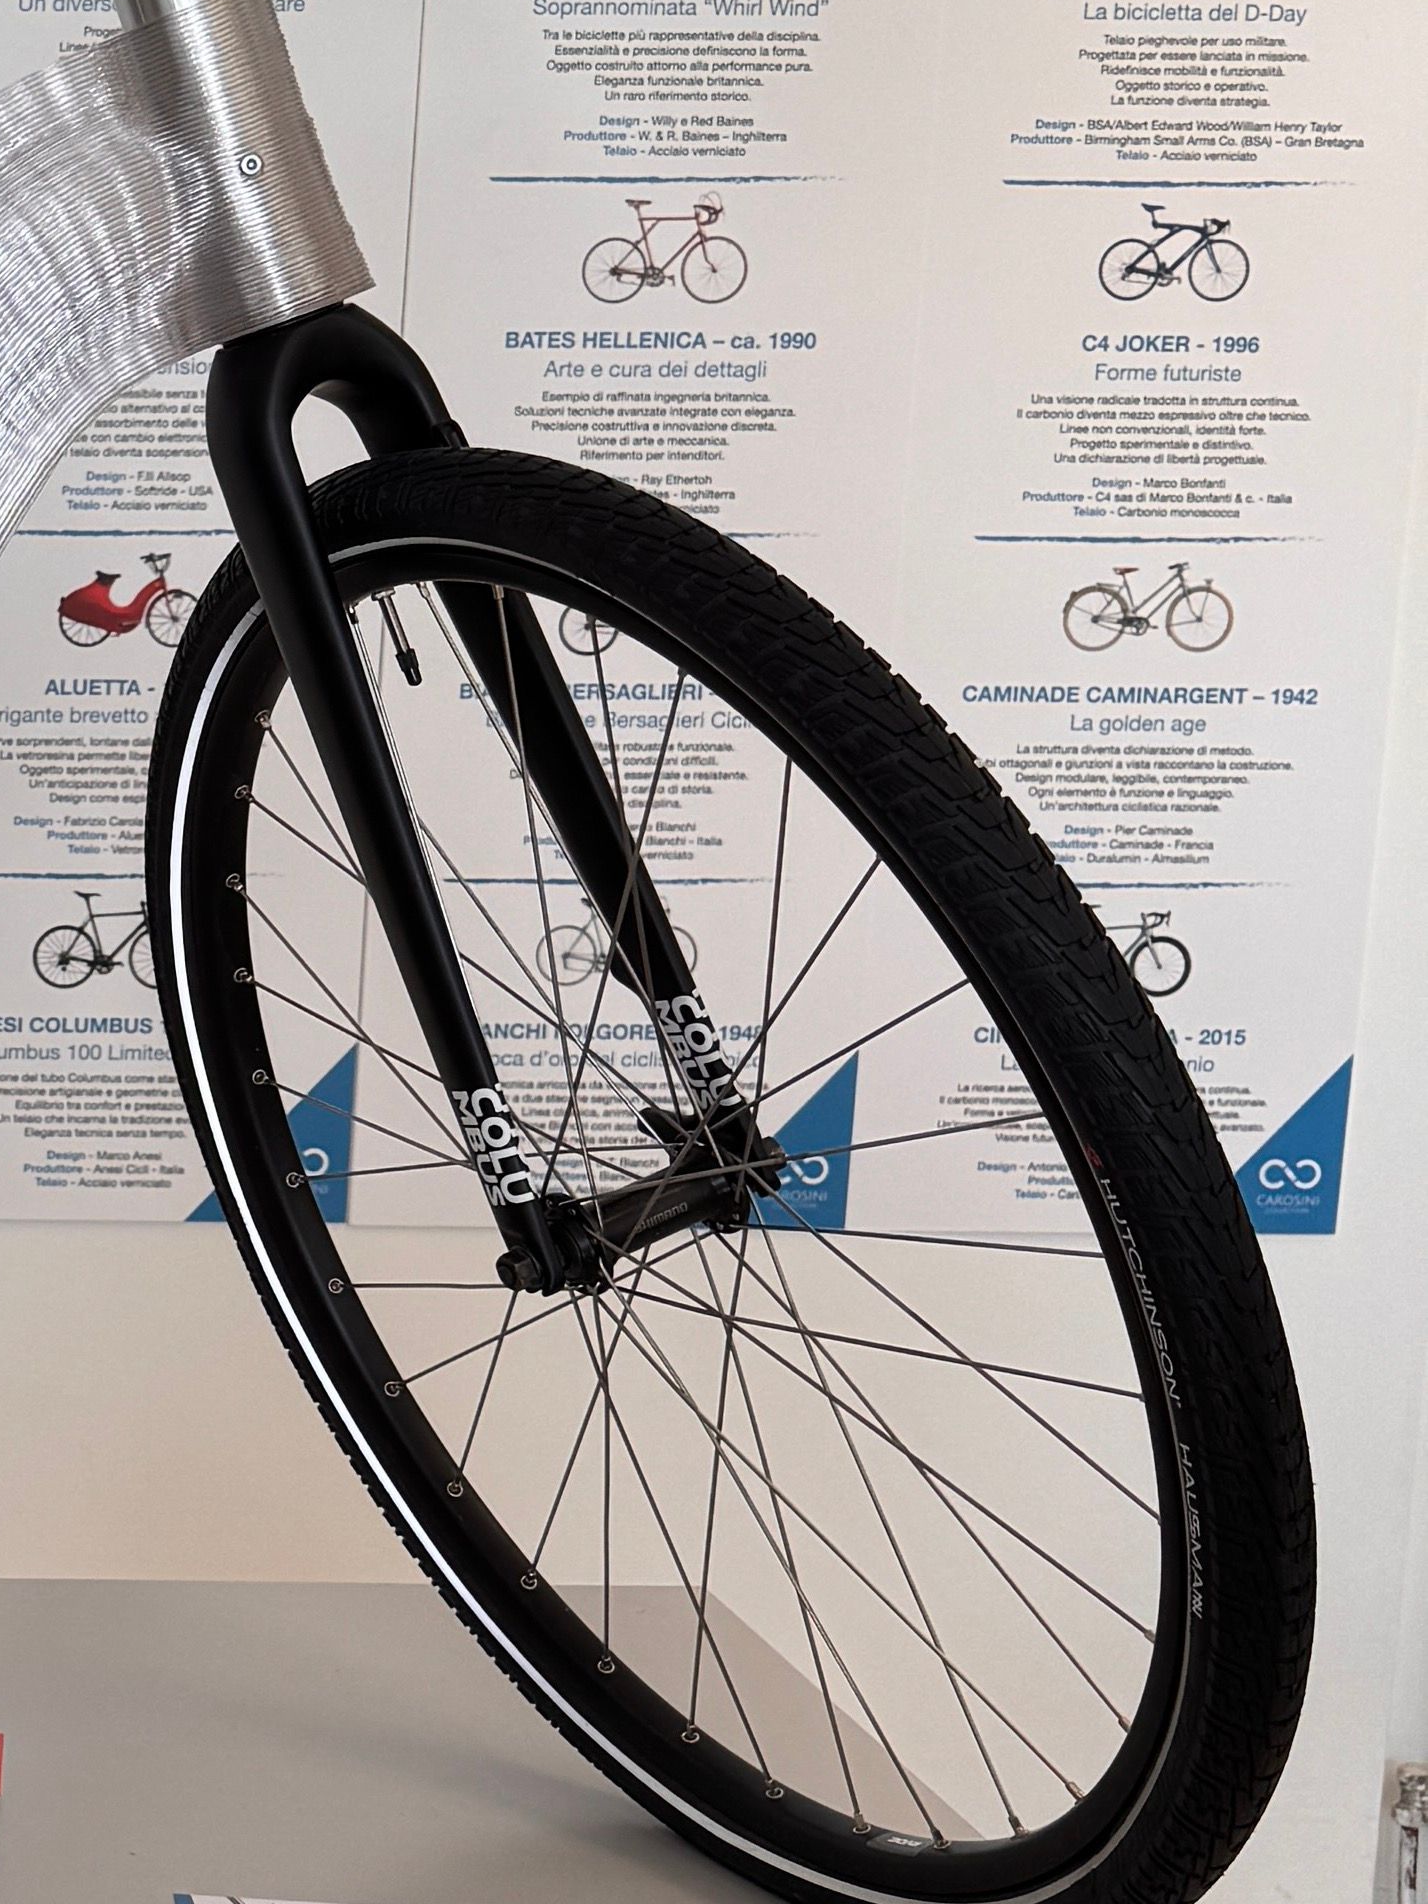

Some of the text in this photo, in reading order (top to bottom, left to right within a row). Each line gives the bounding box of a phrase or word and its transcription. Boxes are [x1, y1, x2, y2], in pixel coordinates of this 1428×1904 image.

[1083, 2, 1308, 27] La bicicletta del D-Day
[1081, 334, 1260, 354] C4 JOKER 1996
[543, 360, 767, 383] Arte e cura dei dettagli
[1094, 362, 1242, 383] Forme futuriste
[962, 685, 1318, 705] CAMINADE CAMINARGENT 1942
[1070, 713, 1207, 737] La golden age
[1198, 1028, 1246, 1046] 2015
[1101, 1178, 1181, 1402] HUTCHINSON
